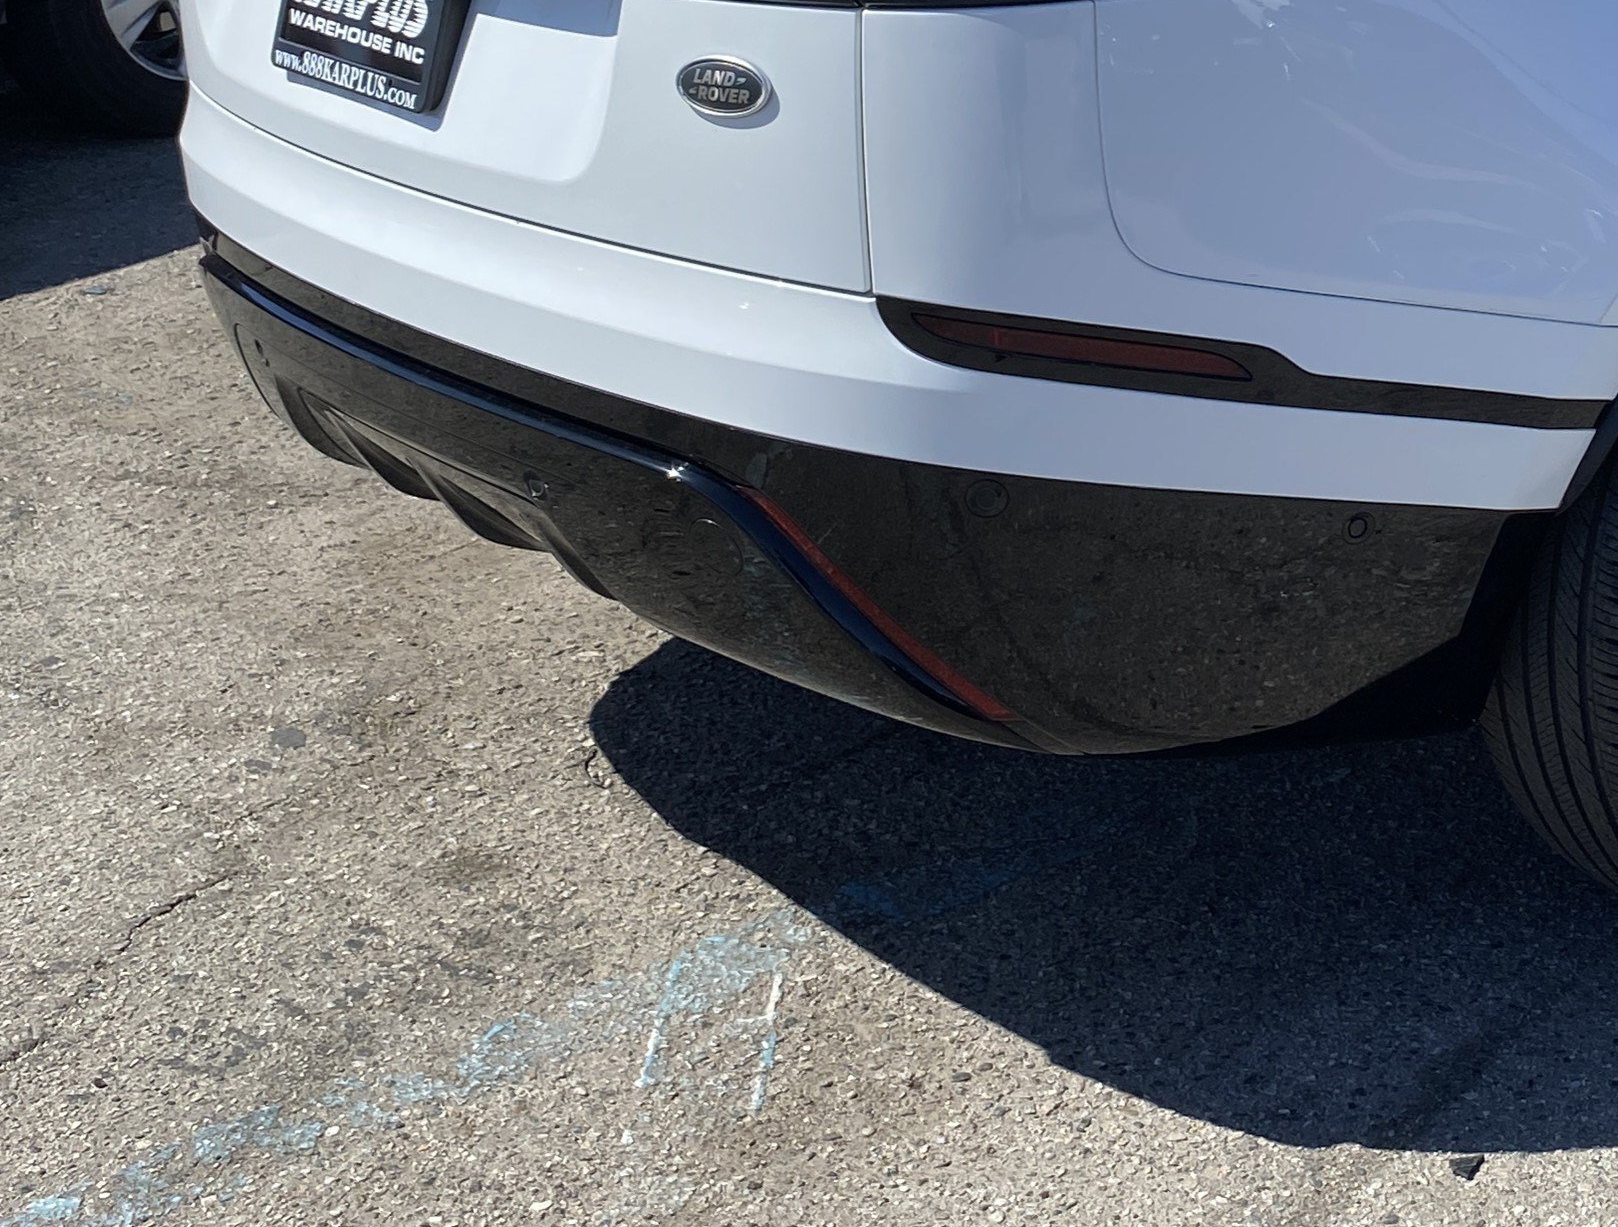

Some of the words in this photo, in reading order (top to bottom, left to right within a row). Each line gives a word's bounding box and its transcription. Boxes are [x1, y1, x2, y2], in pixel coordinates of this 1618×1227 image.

[289, 7, 393, 54] WAREHOUSE
[394, 41, 426, 65] INC
[693, 68, 736, 87] LAND
[697, 85, 750, 104] ROVER
